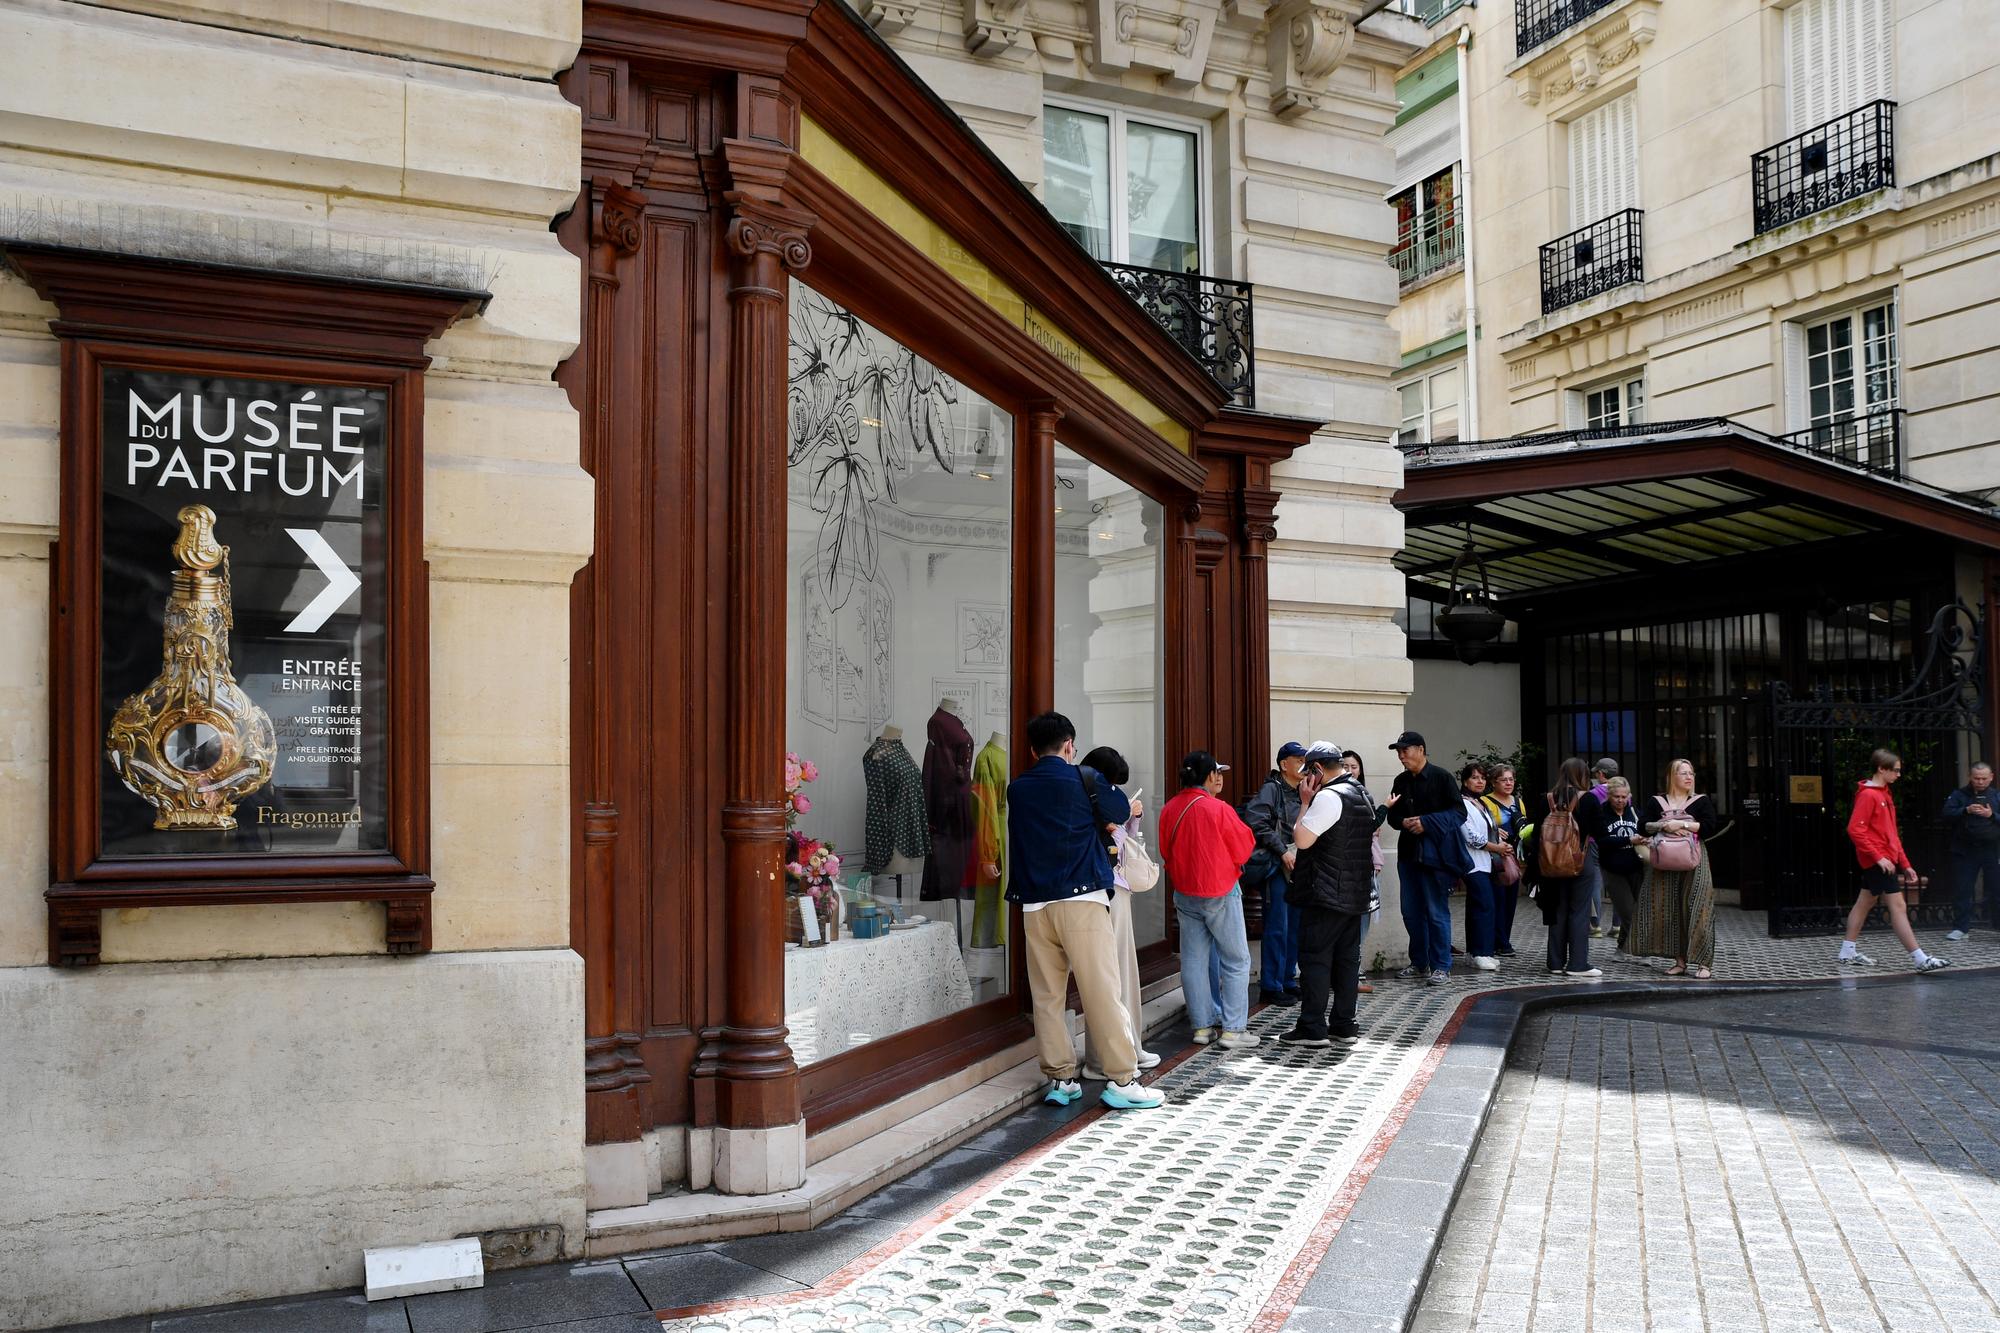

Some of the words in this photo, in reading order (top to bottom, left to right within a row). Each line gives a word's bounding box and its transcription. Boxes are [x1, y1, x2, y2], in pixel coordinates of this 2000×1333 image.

[1023, 301, 1081, 373] Fragonard
[128, 388, 366, 455] MUSÉE
[142, 424, 168, 440] DU
[128, 443, 364, 500] PARFUM
[282, 658, 362, 677] ENTRÉE
[282, 678, 362, 692] ENTRANCE
[311, 704, 348, 715] ENTRÉE
[350, 706, 362, 715] ET
[294, 715, 324, 725] VISITE
[326, 714, 362, 726] GUIDÉE
[310, 726, 362, 736] GRATUITES
[296, 745, 316, 754] FREE
[318, 746, 362, 755] ENTRANCE
[287, 755, 306, 763] AND
[307, 755, 338, 763] GUIDED
[339, 755, 362, 764] TOUR
[256, 805, 363, 829] Fragonard
